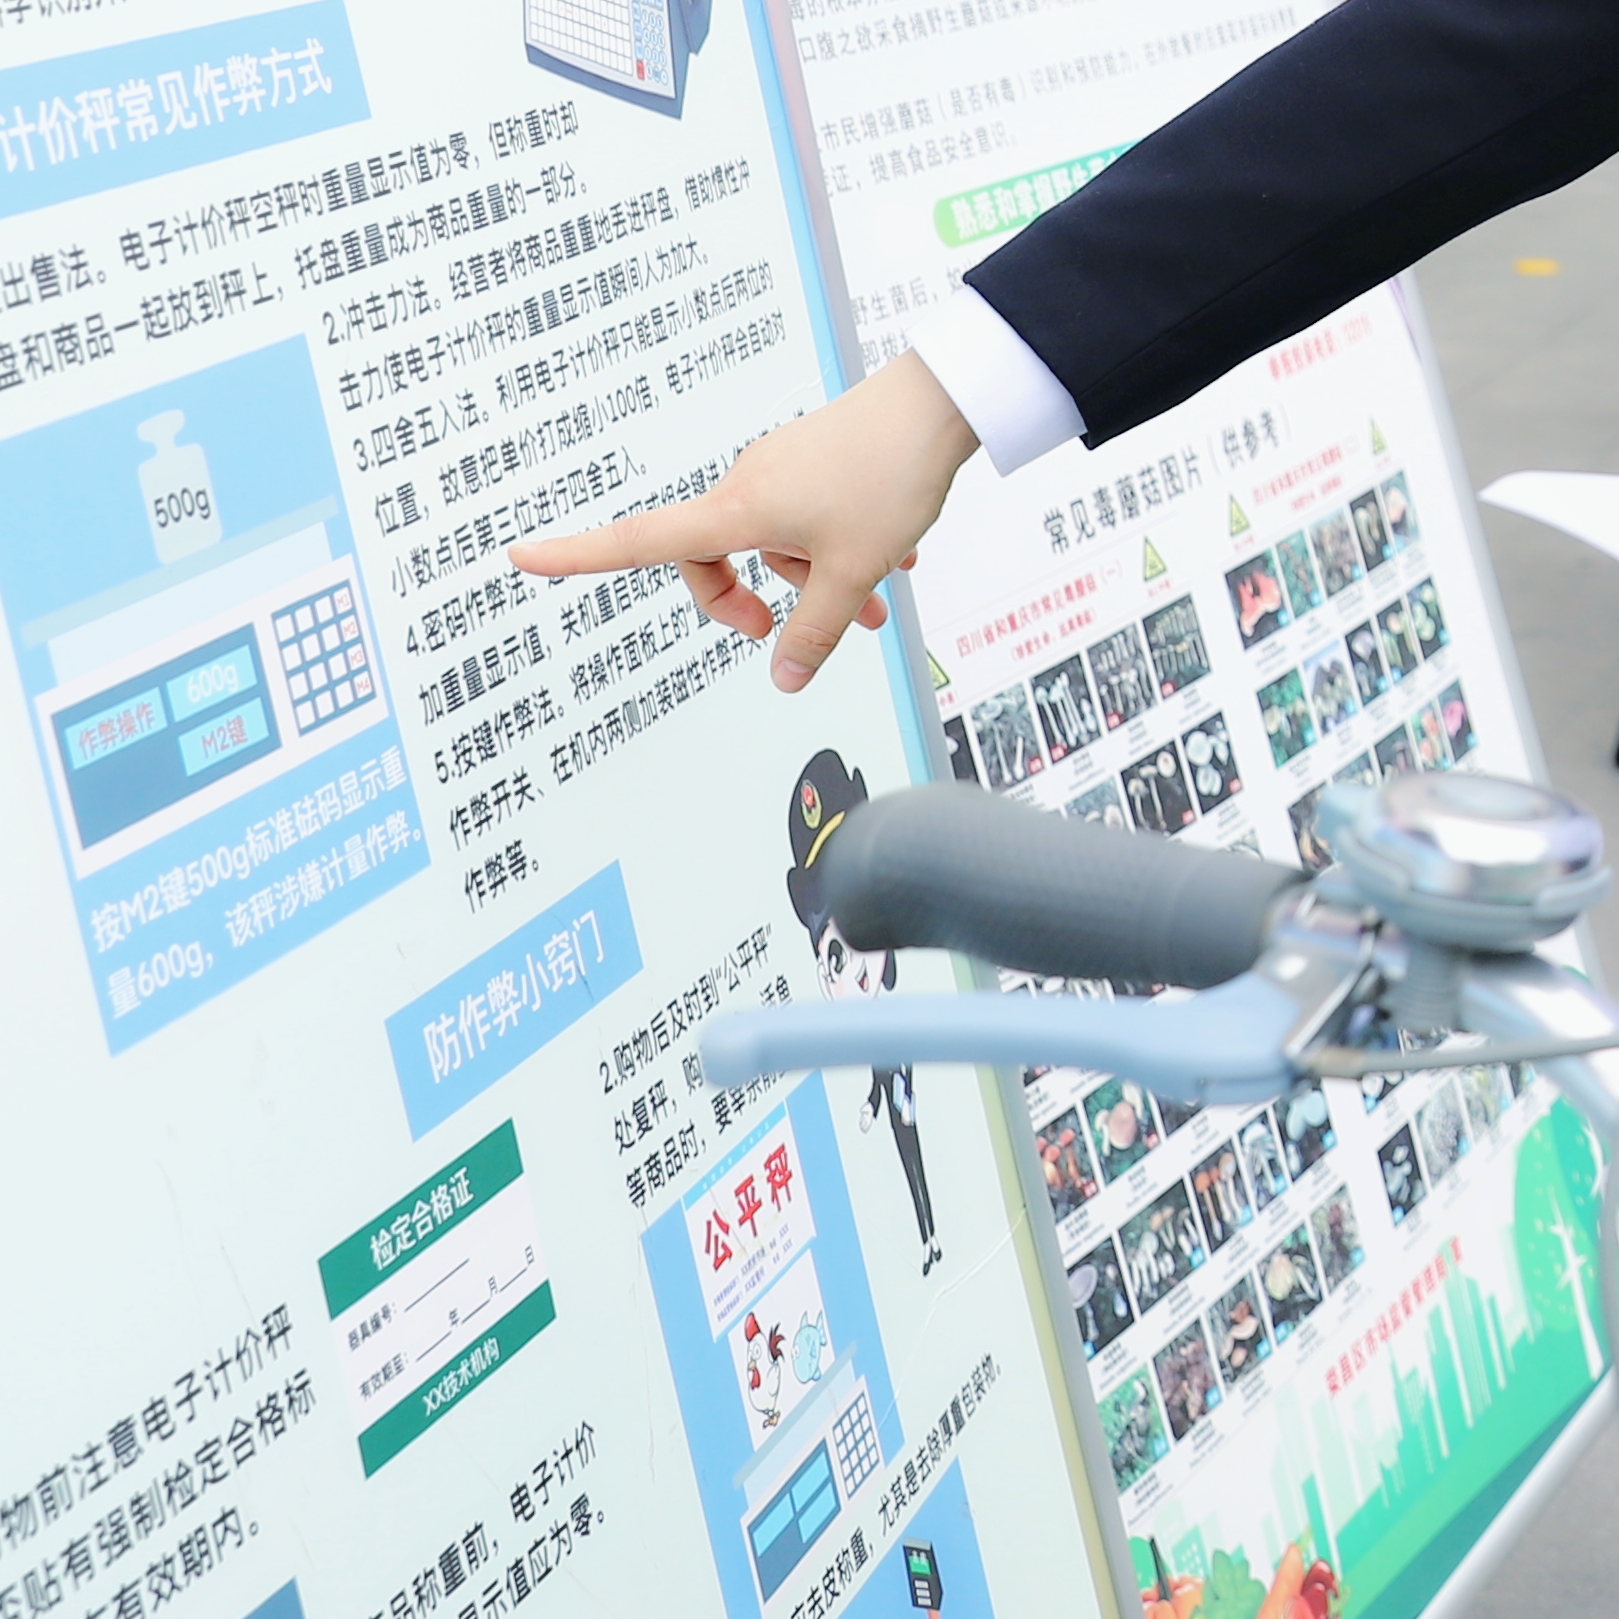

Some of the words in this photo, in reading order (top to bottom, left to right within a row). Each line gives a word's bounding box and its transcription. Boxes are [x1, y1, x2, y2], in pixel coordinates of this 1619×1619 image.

[0, 37, 332, 173] 计价秤常见作弊方式
[0, 99, 580, 316] 出售法。电子计价秤空秤时重量显示值为零，但称重时却
[153, 486, 213, 530] 500g
[186, 661, 240, 704] 600g
[343, 620, 357, 638] M2
[350, 649, 364, 667] M3
[78, 701, 157, 762] 作弊操作
[200, 713, 249, 762] M2键
[90, 744, 408, 955] 按M2键500g标准砝码显示重
[422, 909, 605, 1084] 防作弊小窍门
[369, 1165, 475, 1272] 检定合格证
[703, 1141, 795, 1273] 公平秤
[448, 1307, 462, 1330] 年
[487, 1274, 500, 1298] 月
[524, 1243, 536, 1268] 日
[83, 1504, 260, 1619] 有效期内。
[367, 1419, 596, 1619] 品称重前，电子计价
